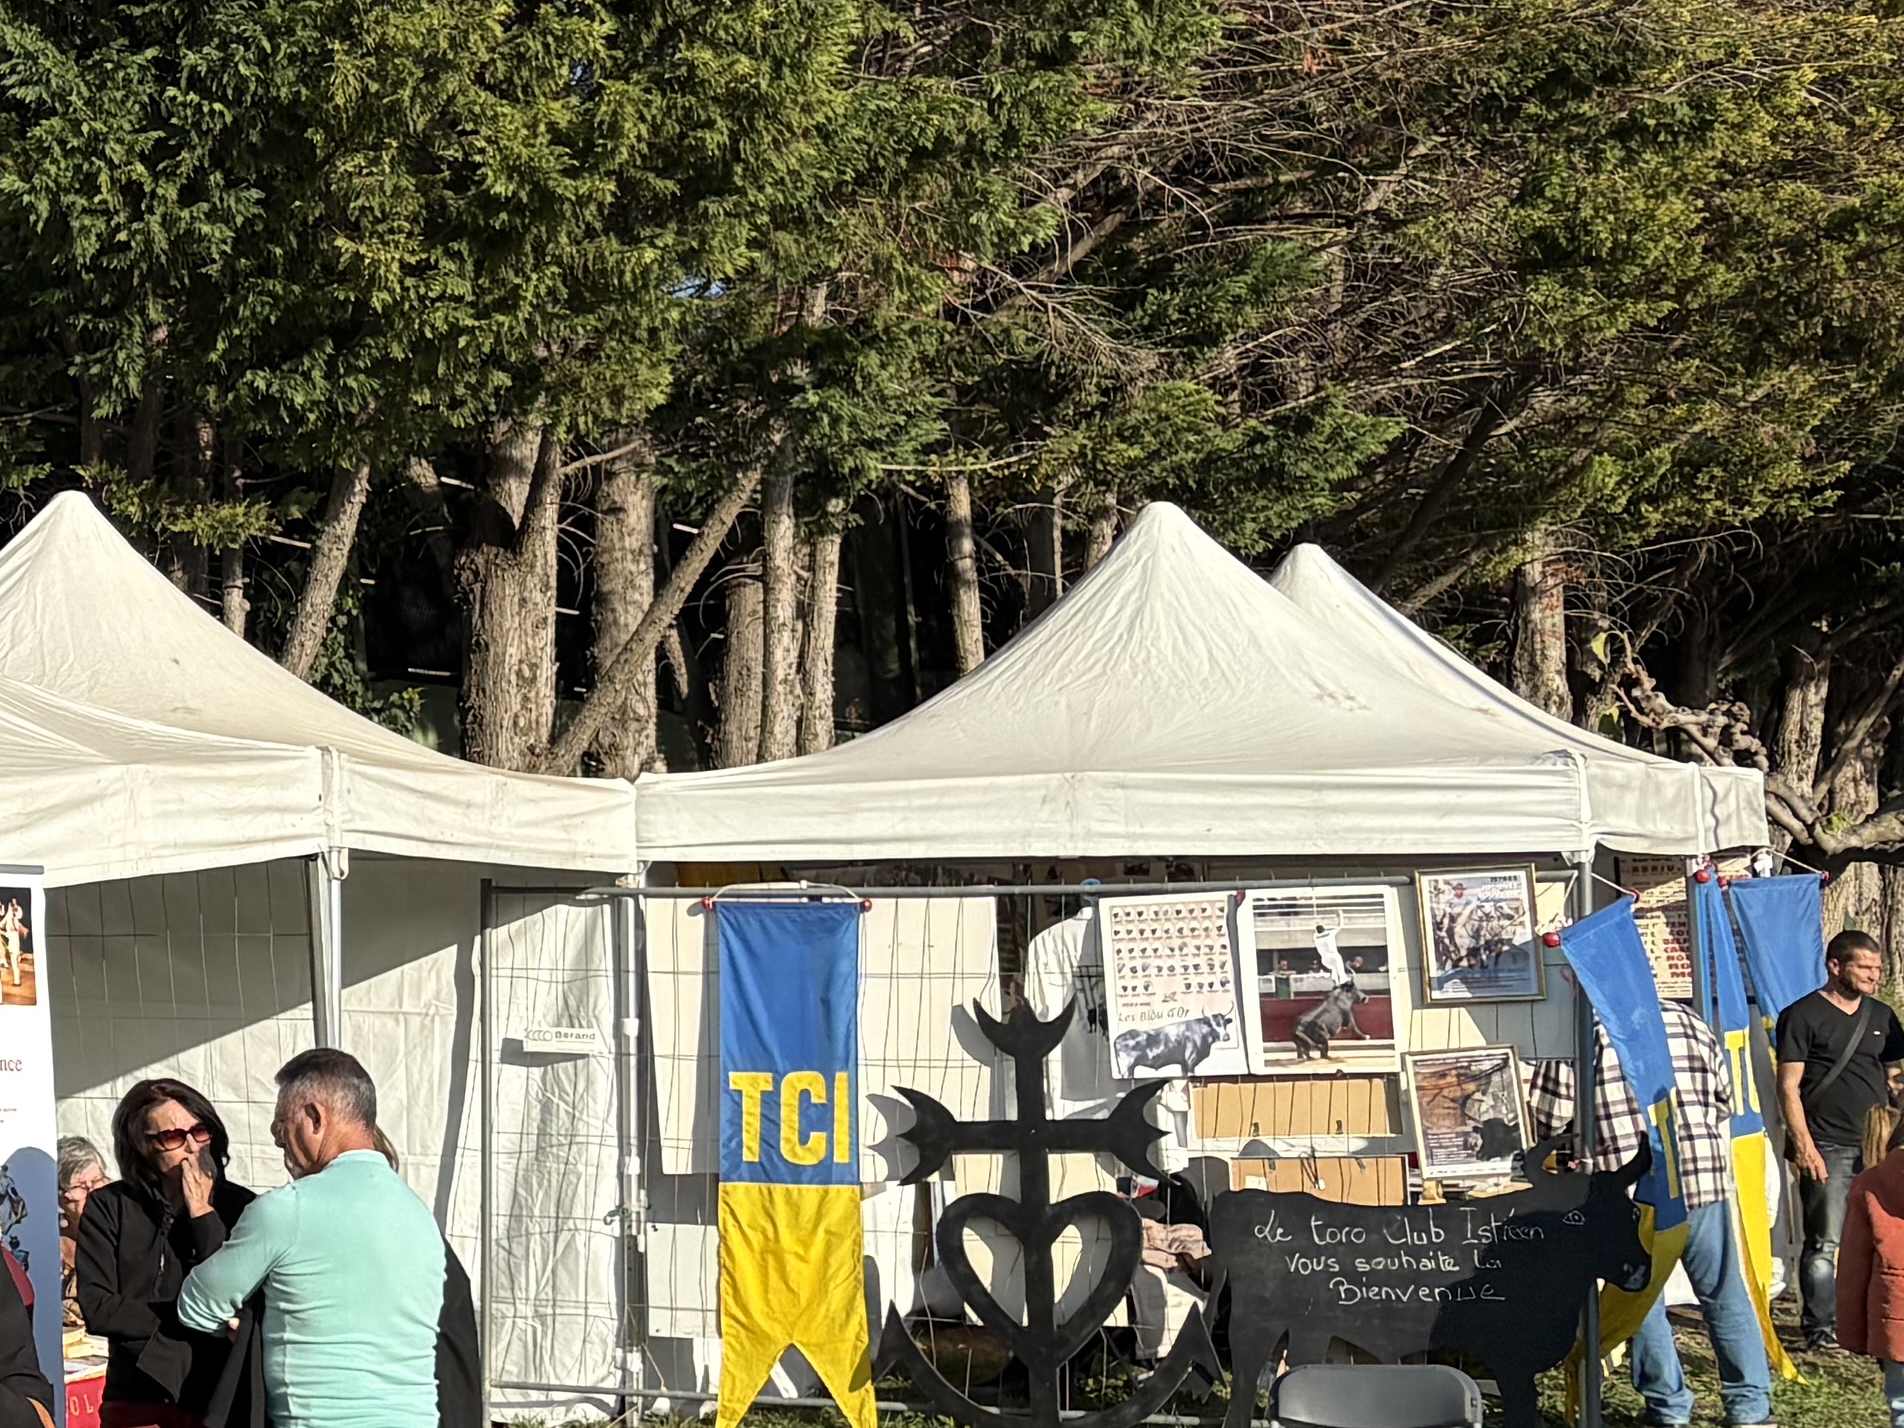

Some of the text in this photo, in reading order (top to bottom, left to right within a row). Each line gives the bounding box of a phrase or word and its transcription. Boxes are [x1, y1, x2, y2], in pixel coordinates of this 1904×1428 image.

[728, 1070, 851, 1166] TCI
[1254, 1209, 1292, 1244] Le
[1384, 1207, 1445, 1246] Club
[1354, 1250, 1460, 1272] souhaite
[1329, 1276, 1506, 1305] Bienvenue
